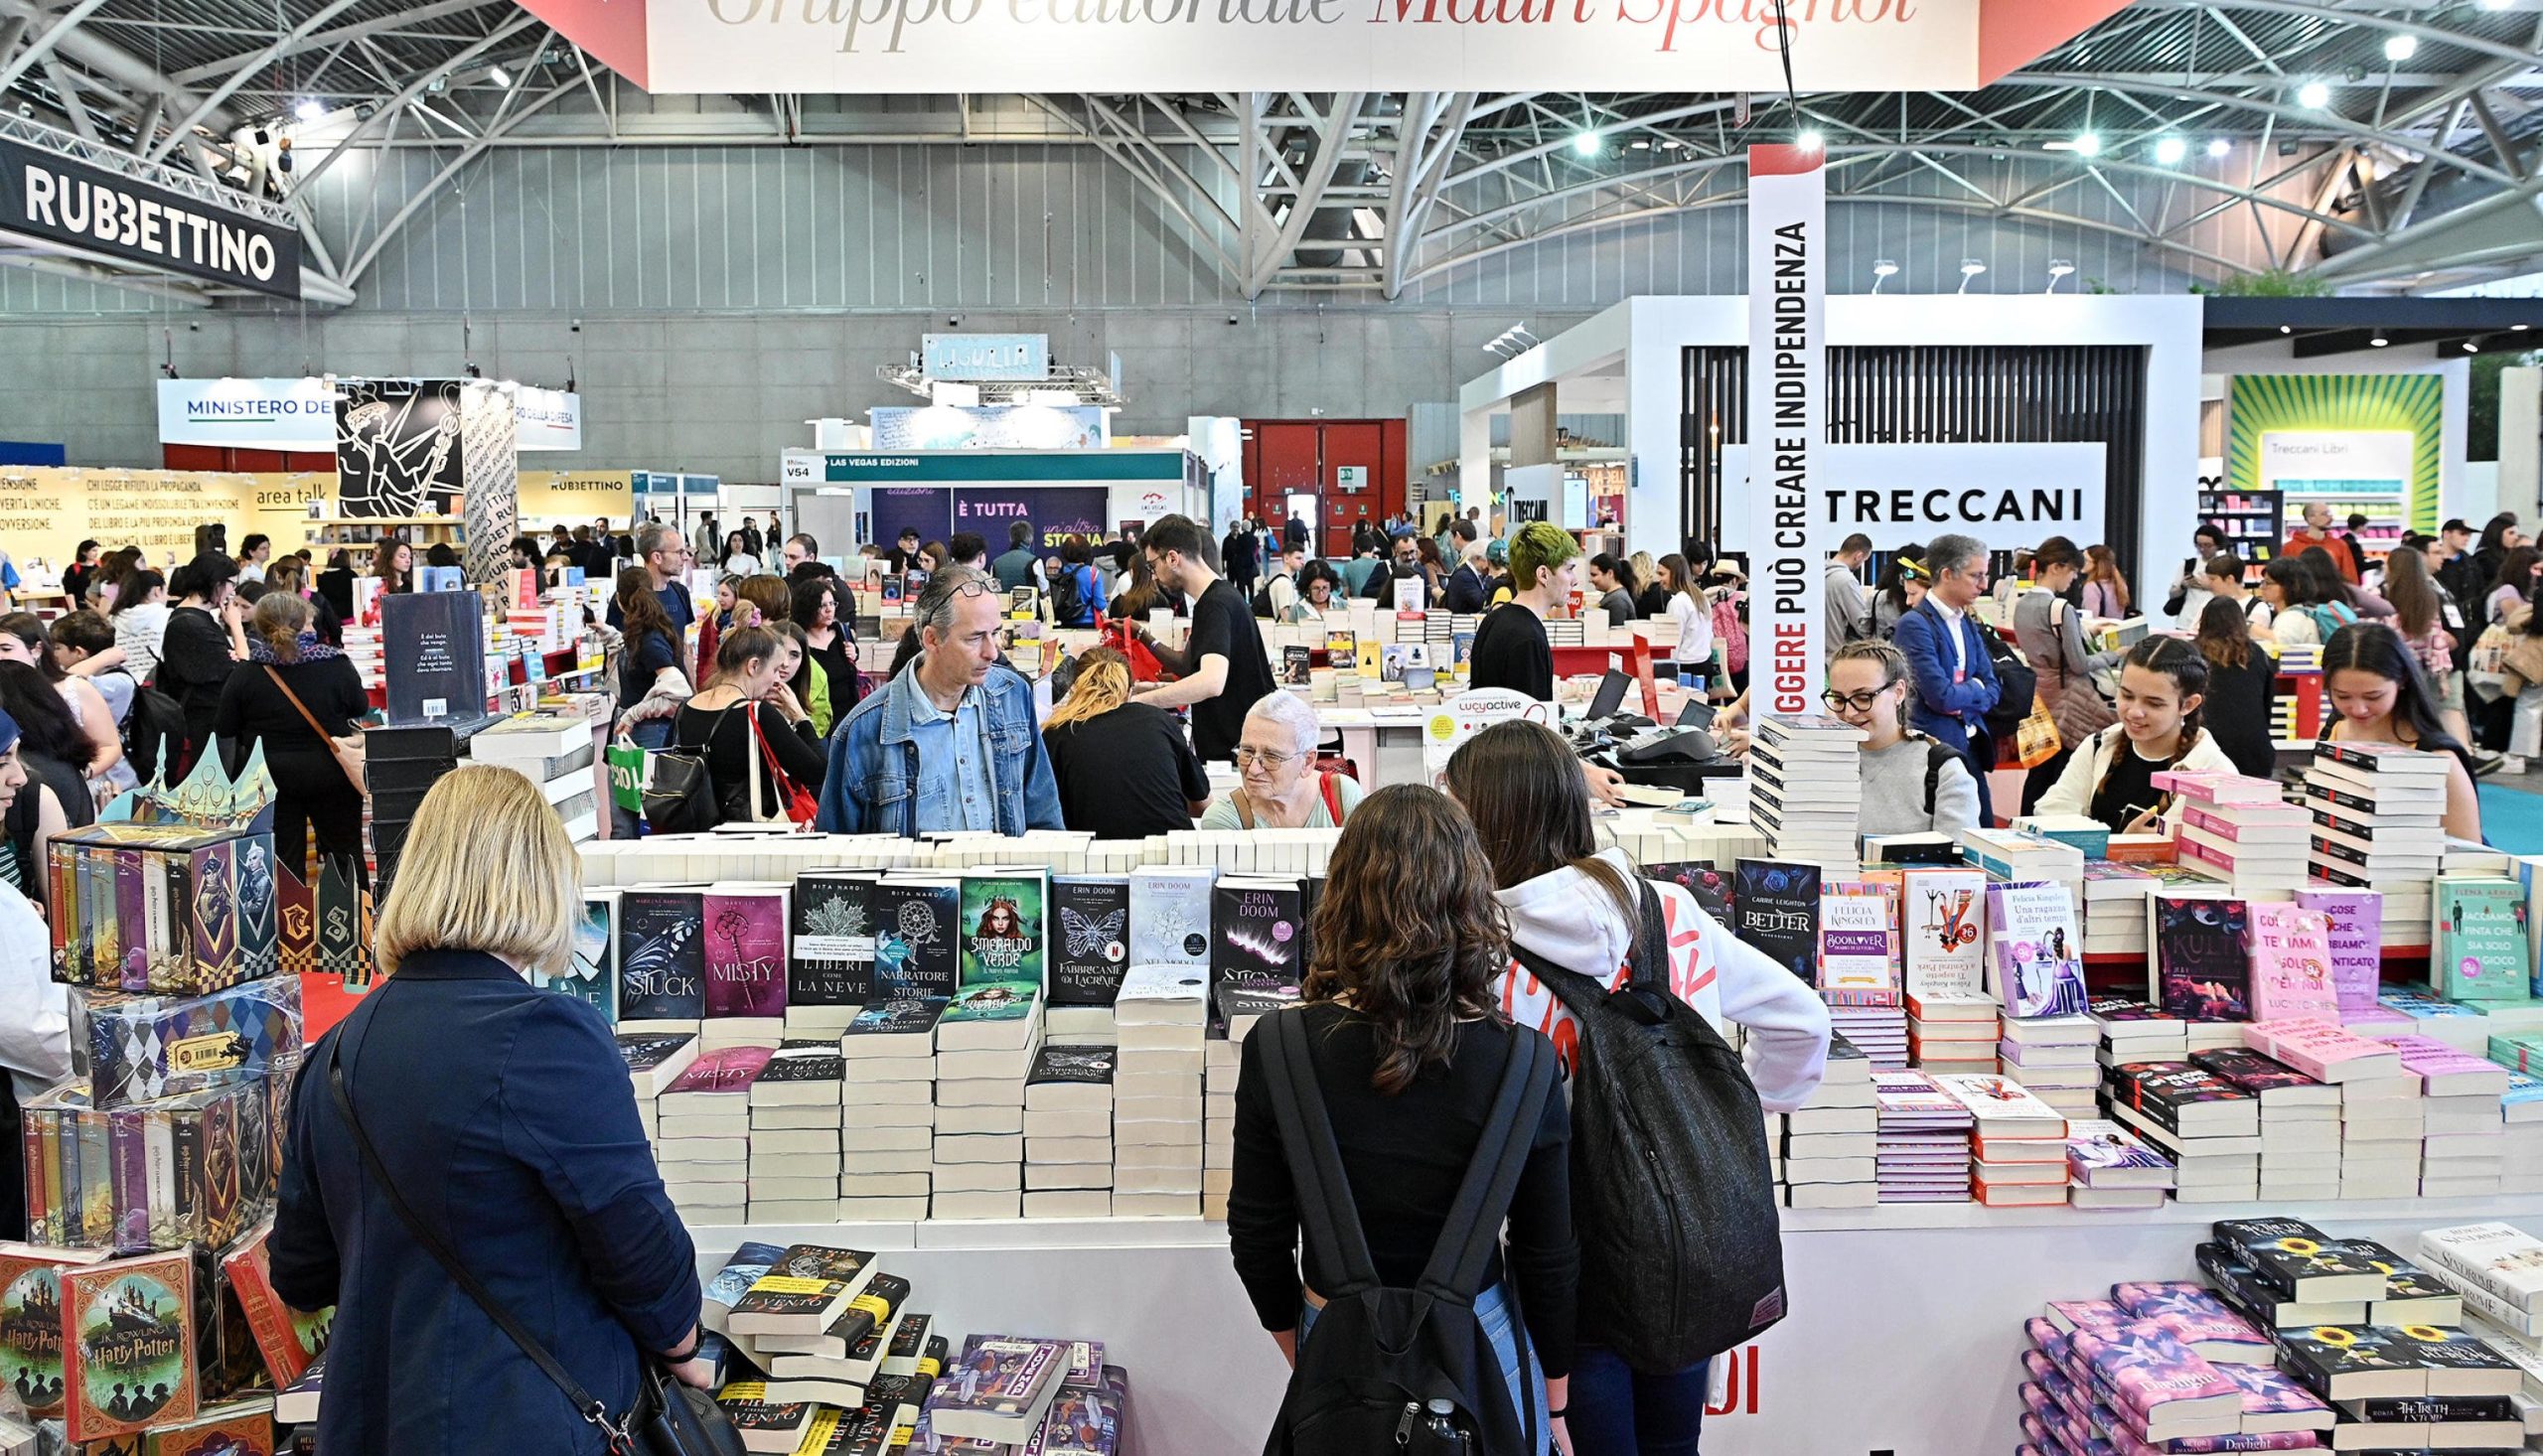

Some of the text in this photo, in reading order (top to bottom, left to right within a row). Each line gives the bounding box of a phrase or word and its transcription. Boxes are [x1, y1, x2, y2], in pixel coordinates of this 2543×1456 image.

[1774, 221, 1806, 428] INDIPENDENZA
[940, 344, 1029, 368] LIGURIA
[188, 399, 297, 415] MINISTERO
[527, 408, 548, 421] DELLA
[551, 411, 574, 424] DIFESA
[2272, 443, 2349, 455] Treccani Libri
[788, 468, 810, 477] V54
[256, 483, 326, 504] area talk
[1774, 437, 1806, 548] CREARE
[973, 503, 1028, 517] TUTTA
[1825, 489, 2083, 524] TRECCANI
[1043, 516, 1103, 534] un'altra
[1043, 532, 1104, 548] STIA
[1766, 557, 1806, 614] PUÒ
[1459, 699, 1521, 713] lucyactive
[1072, 886, 1116, 895] ERIN DOOM
[1147, 881, 1191, 891] ERIN DOOM
[1244, 892, 1274, 905] ERIN
[1751, 896, 1806, 908] CARRIE LEIGHTON
[2012, 894, 2035, 903] Felicia
[1240, 905, 1278, 918] DOOM
[1835, 906, 1872, 915] FELICIA
[2014, 905, 2067, 916] Una ragazza
[2330, 905, 2357, 916] COSE
[1741, 908, 1811, 933] BETTER
[1831, 915, 1876, 928] KINGSLEY
[2016, 913, 2067, 926] d'altri tempi
[2333, 923, 2353, 933] CHE
[2465, 926, 2513, 937] FINTA CHE
[971, 937, 1032, 953] SMERALDO
[2467, 941, 2511, 950] SIA SOLO
[981, 952, 1021, 968] VERDE
[2482, 955, 2516, 966] GIOCO
[713, 954, 776, 983] MISTY
[880, 969, 949, 982] NARRATORE
[1059, 960, 1124, 976] FABBRICANTE
[629, 968, 696, 997] STUCK
[798, 979, 867, 994] LA NEVE
[1075, 974, 1122, 989] LACRIME
[893, 986, 936, 998] STORIE
[682, 1067, 752, 1081] MISTY
[2442, 1250, 2497, 1295] SINDROME
[2438, 1271, 2497, 1315] SINDROME
[764, 1296, 823, 1308] VENTO
[8, 1329, 38, 1352] Harry
[94, 1343, 133, 1371] Harry
[134, 1337, 176, 1365] Potter
[1010, 1351, 1046, 1395] LOVE MAP
[2138, 1374, 2220, 1392] Daylight
[732, 1410, 797, 1422] VENTO
[2224, 1437, 2272, 1452] Daylight
